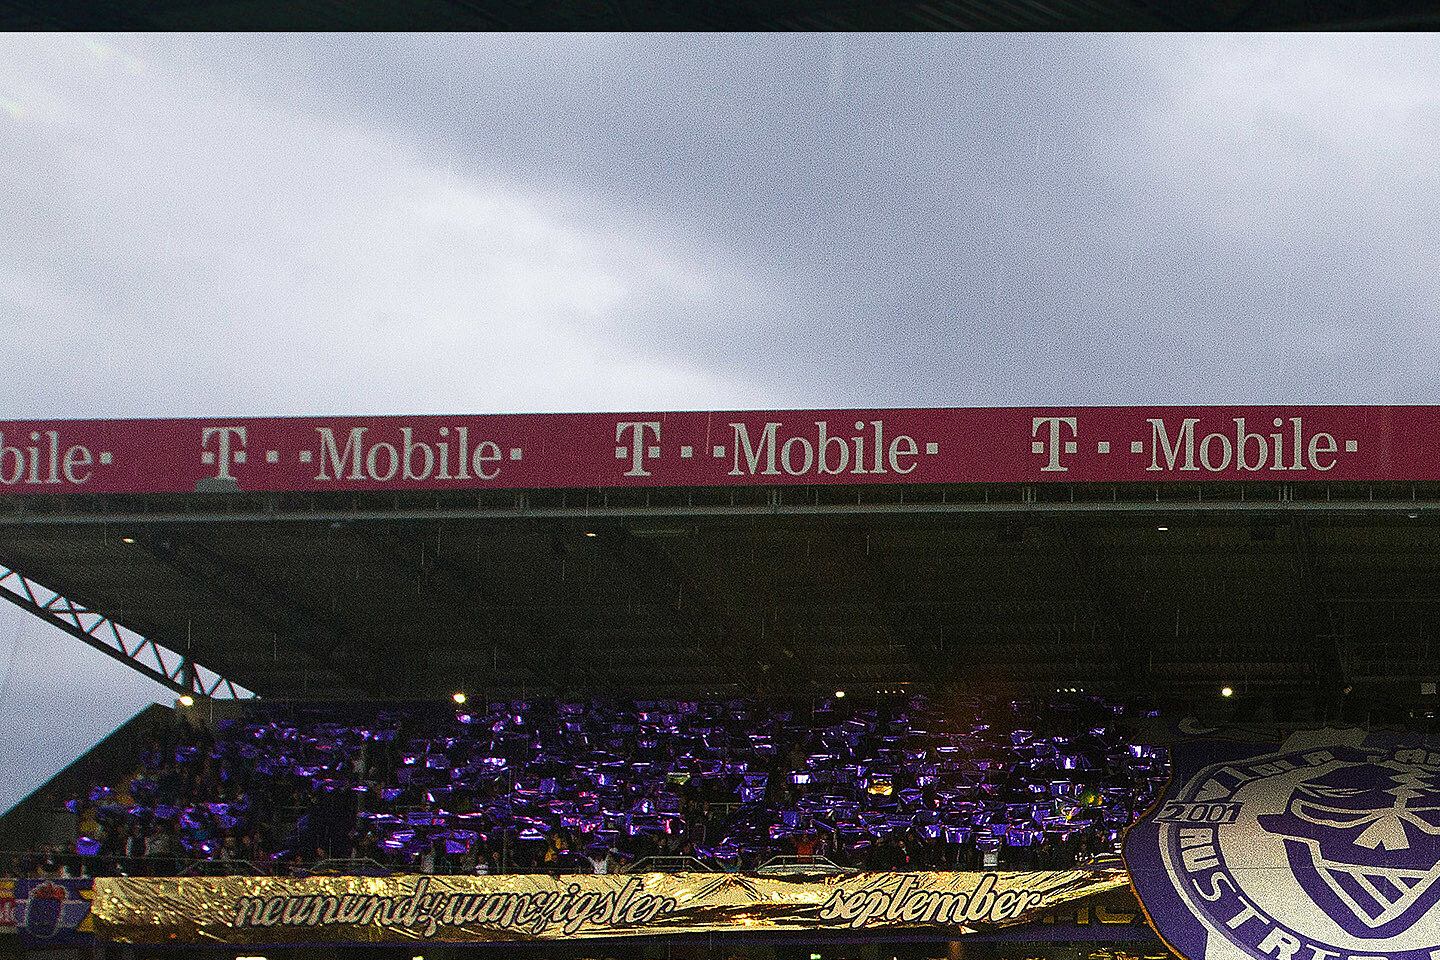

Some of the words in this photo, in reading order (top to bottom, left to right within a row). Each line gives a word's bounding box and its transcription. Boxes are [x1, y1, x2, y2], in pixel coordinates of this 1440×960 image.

[315, 427, 501, 481] Mobile
[729, 421, 918, 475] Mobile
[1147, 418, 1337, 471] Mobile
[1157, 804, 1241, 822] 2001
[820, 873, 1043, 929] september
